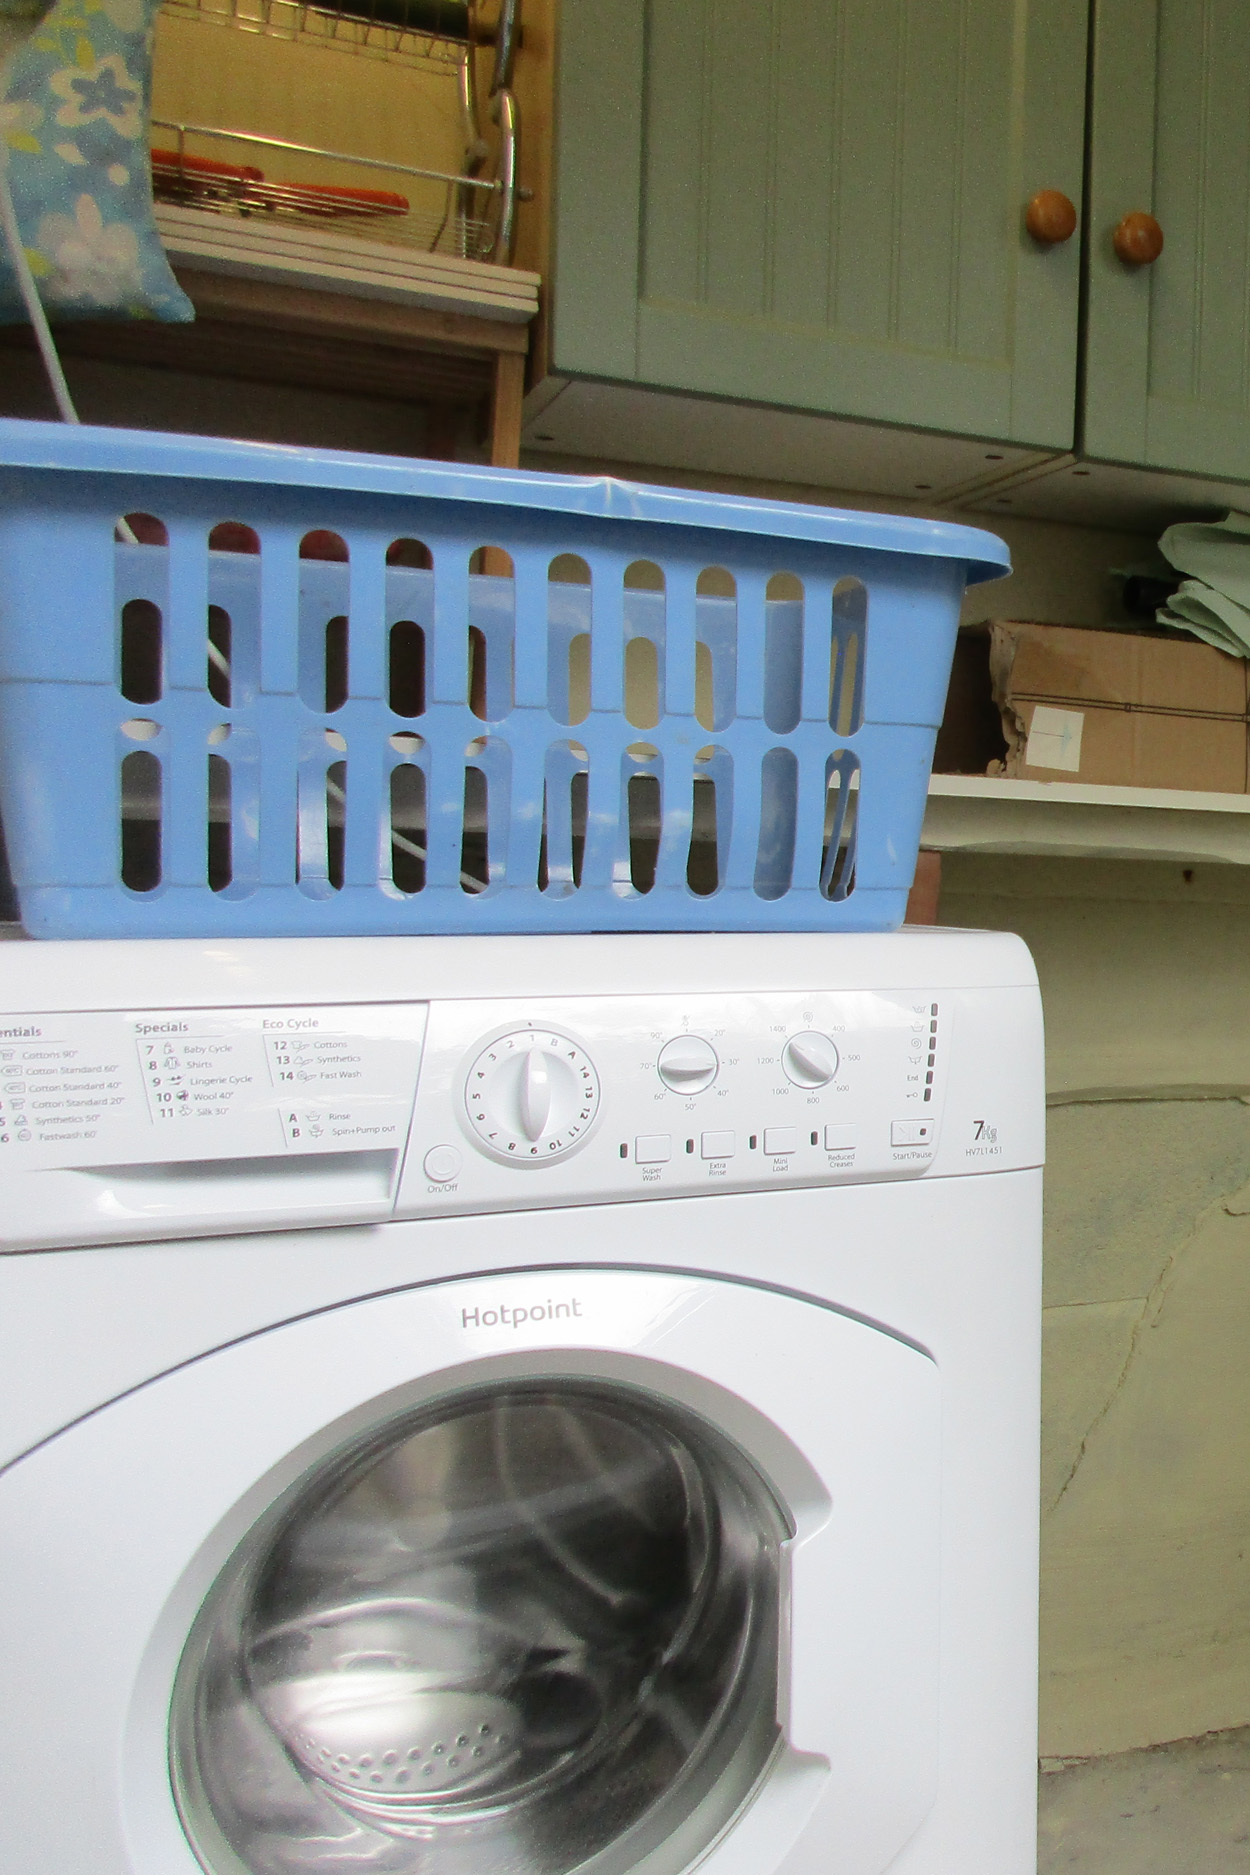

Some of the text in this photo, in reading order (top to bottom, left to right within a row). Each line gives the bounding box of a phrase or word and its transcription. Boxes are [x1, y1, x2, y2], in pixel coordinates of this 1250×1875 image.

[287, 1018, 319, 1029] Cycle
[135, 1022, 189, 1035] Specials
[769, 1025, 786, 1033] 1400
[273, 1041, 287, 1050] 12
[276, 1056, 290, 1065] 13
[149, 1061, 157, 1071] 8
[280, 1072, 294, 1081] 14
[907, 1074, 919, 1082] End
[153, 1077, 161, 1087] 9
[836, 1084, 849, 1092] 600
[156, 1093, 172, 1102] 10
[160, 1108, 174, 1118] 11
[289, 1113, 298, 1123] A
[292, 1128, 300, 1138] B
[893, 1151, 932, 1161] Start/Pause
[773, 1157, 788, 1165] Mini
[709, 1168, 727, 1176] Rinse
[772, 1164, 788, 1172] Load
[427, 1183, 458, 1193] On/Off
[462, 1298, 583, 1329] Hotpoint
